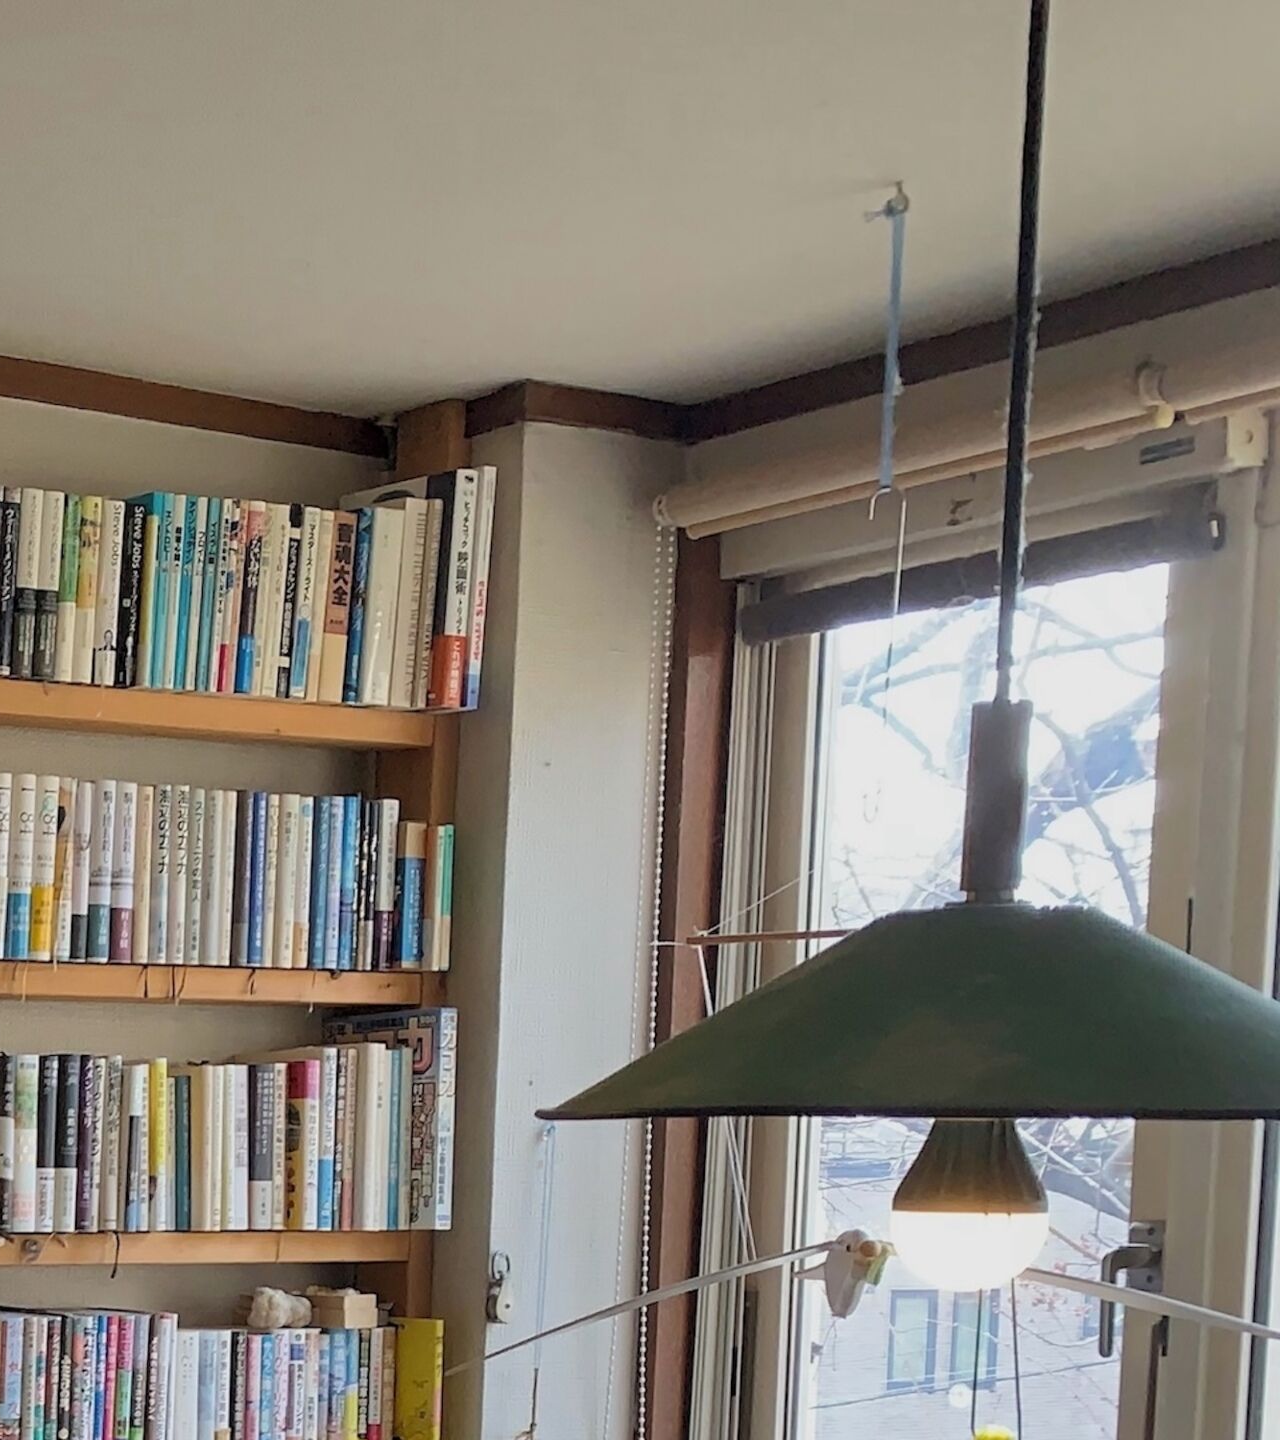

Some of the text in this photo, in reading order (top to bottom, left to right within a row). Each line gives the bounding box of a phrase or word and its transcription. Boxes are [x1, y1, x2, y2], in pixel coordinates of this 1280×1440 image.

[110, 503, 123, 567] Steve Jobs
[131, 505, 145, 570] Steve Jobs
[19, 787, 36, 835] 184
